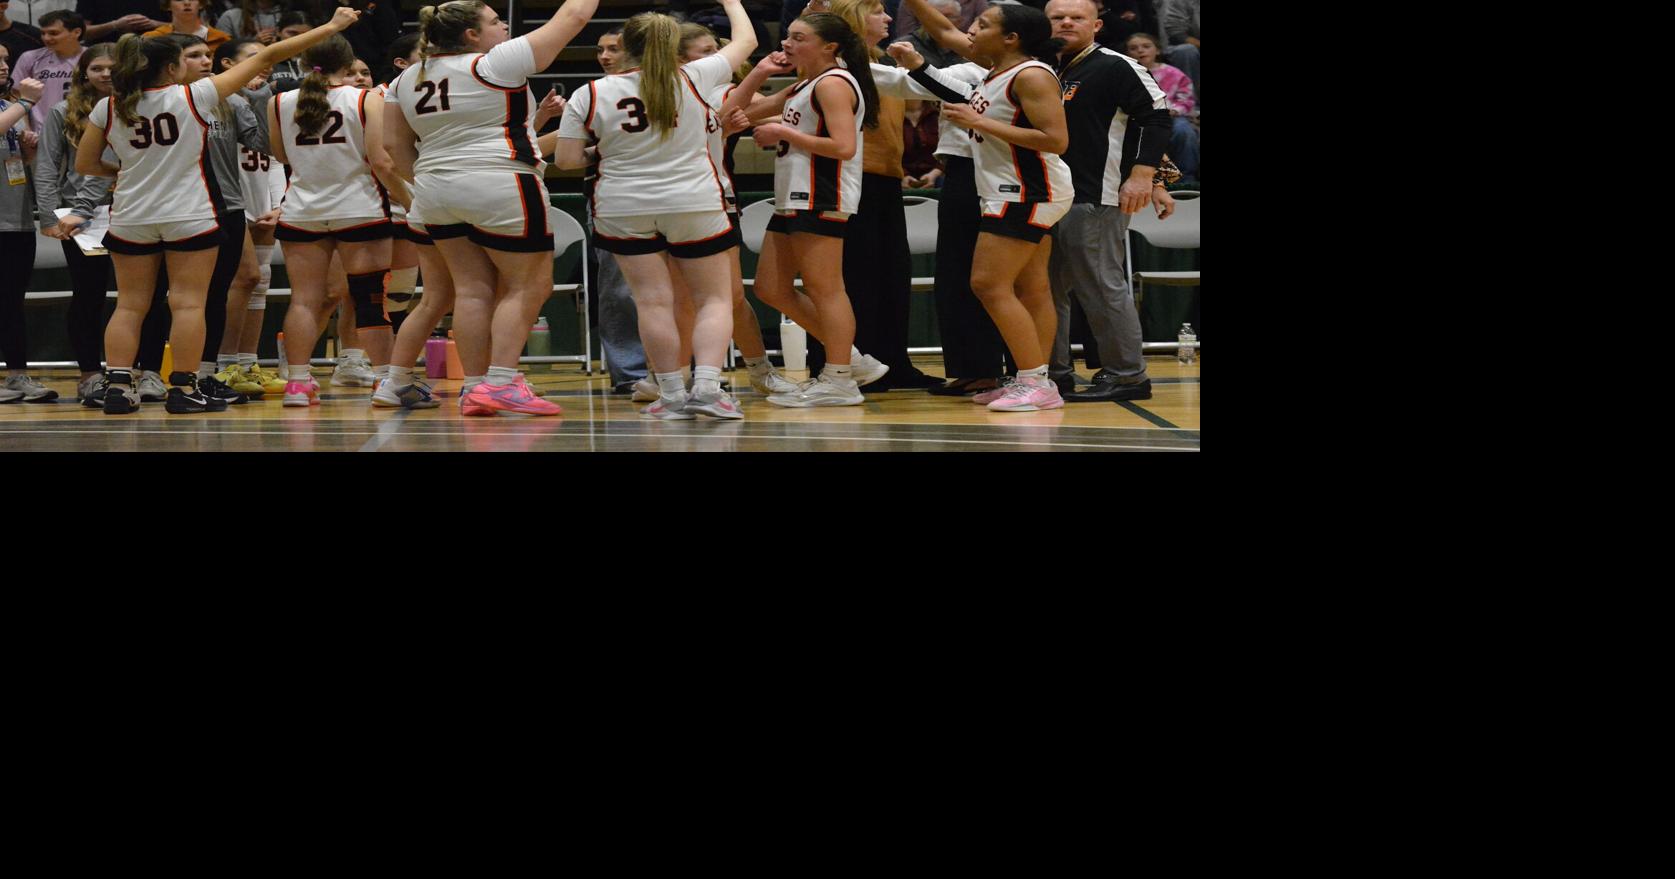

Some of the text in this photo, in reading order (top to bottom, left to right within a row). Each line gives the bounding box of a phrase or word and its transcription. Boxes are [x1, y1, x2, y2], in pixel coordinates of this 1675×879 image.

[414, 78, 450, 114] 21
[127, 111, 180, 150] 30
[241, 147, 270, 172] 35
